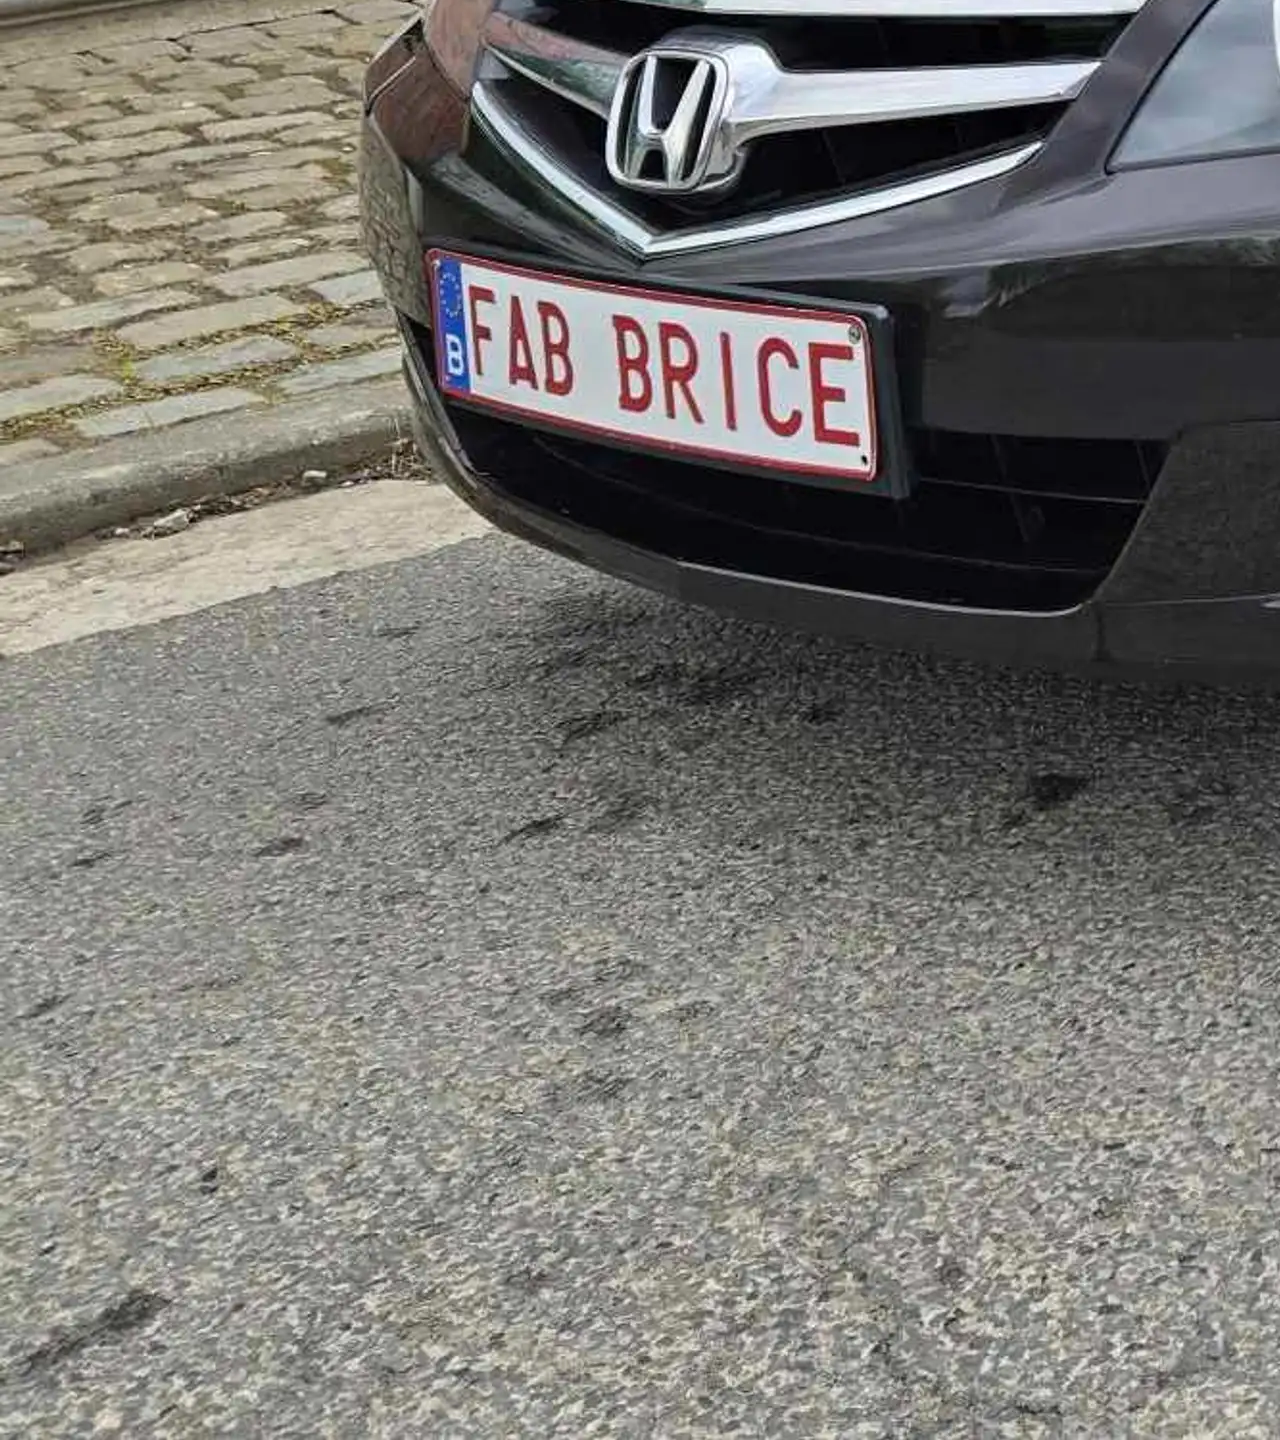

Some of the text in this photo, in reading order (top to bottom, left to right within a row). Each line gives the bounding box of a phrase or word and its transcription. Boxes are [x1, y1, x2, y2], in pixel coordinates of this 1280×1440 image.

[445, 333, 464, 376] B
[469, 285, 861, 447] FAB BRICE
